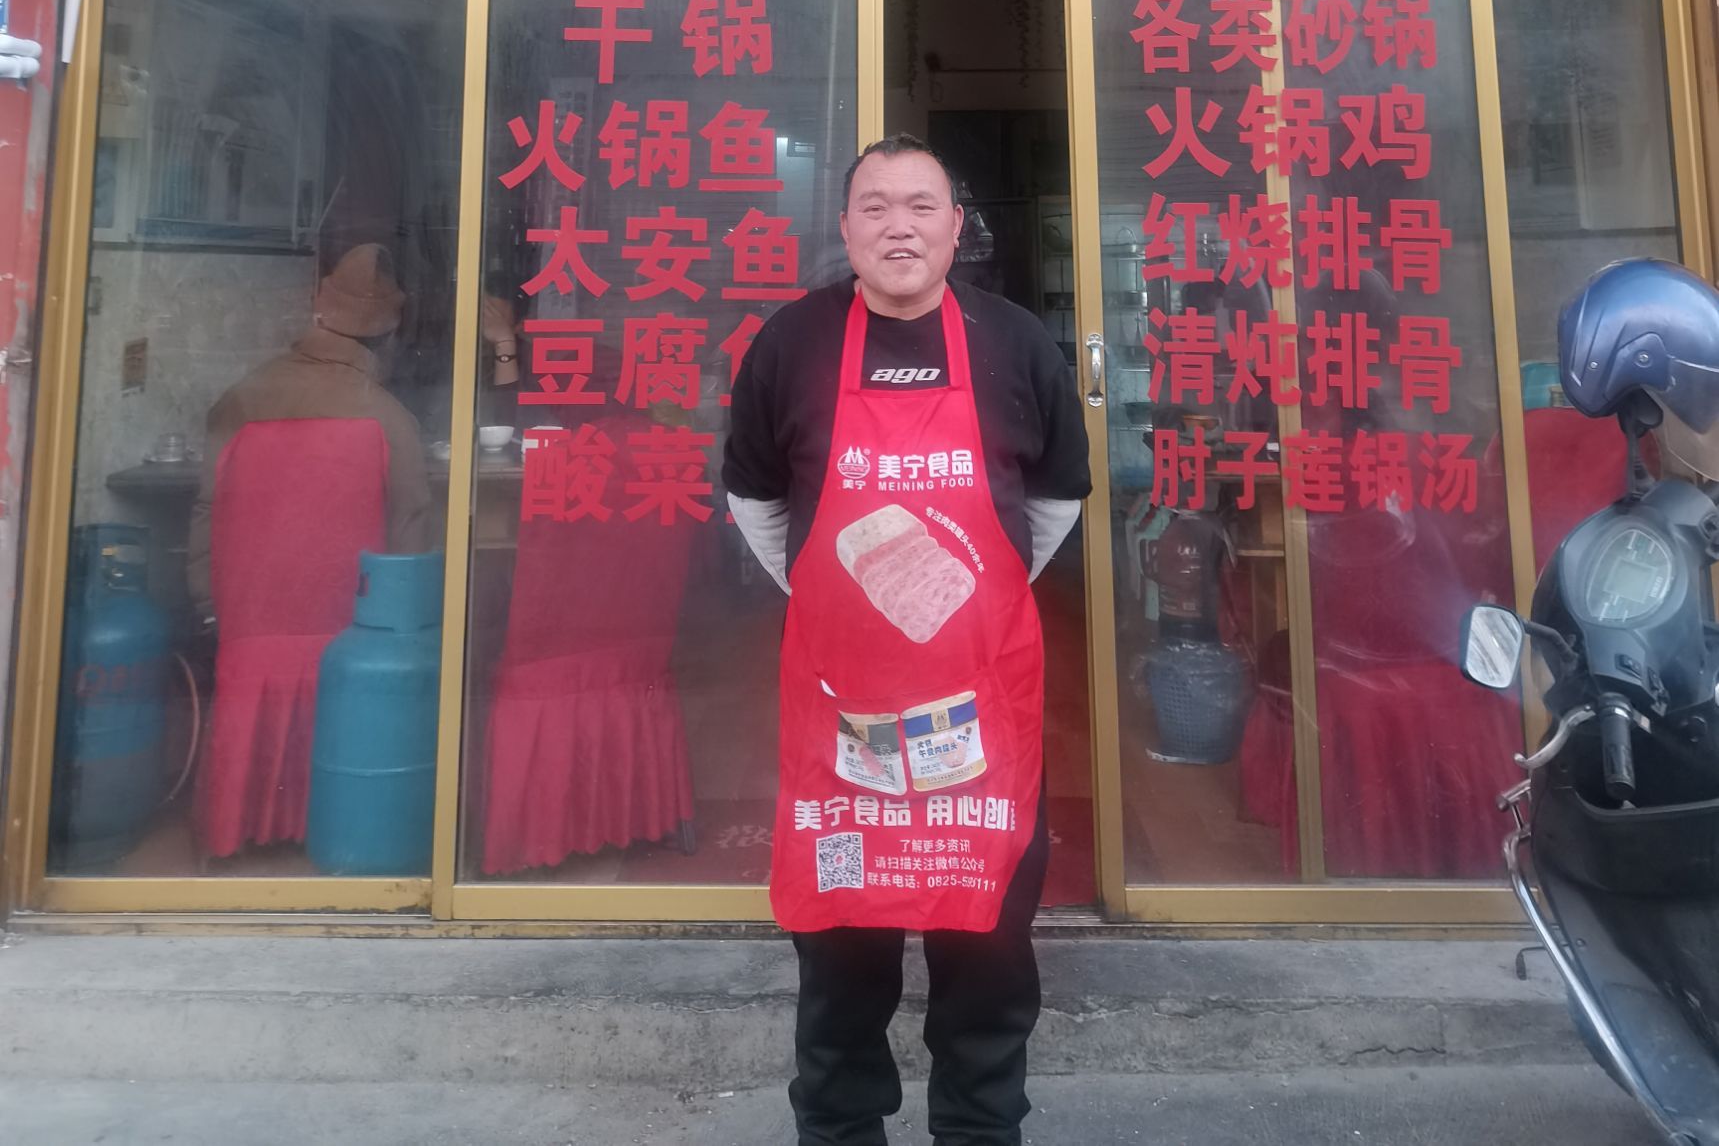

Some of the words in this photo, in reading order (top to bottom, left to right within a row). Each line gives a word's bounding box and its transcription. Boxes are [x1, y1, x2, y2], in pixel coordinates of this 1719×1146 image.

[498, 100, 784, 192] 火锅鱼
[1142, 85, 1432, 180] 火锅鸡
[521, 206, 808, 302] 太安鱼
[1142, 193, 1452, 295] 红烧排骨
[517, 312, 764, 411] 豆腐
[870, 367, 941, 384] ago
[1143, 307, 1462, 414] 清炖排骨
[520, 422, 735, 526] 酸菜
[878, 449, 974, 479] 美宁食品
[878, 480, 935, 491] MEINING
[940, 477, 974, 488] FOOD
[1150, 425, 1480, 515] 肘子莲锅汤
[794, 795, 911, 831] 美宁食品
[926, 796, 1016, 831] 用心创
[900, 838, 970, 853] 了解更多资讯
